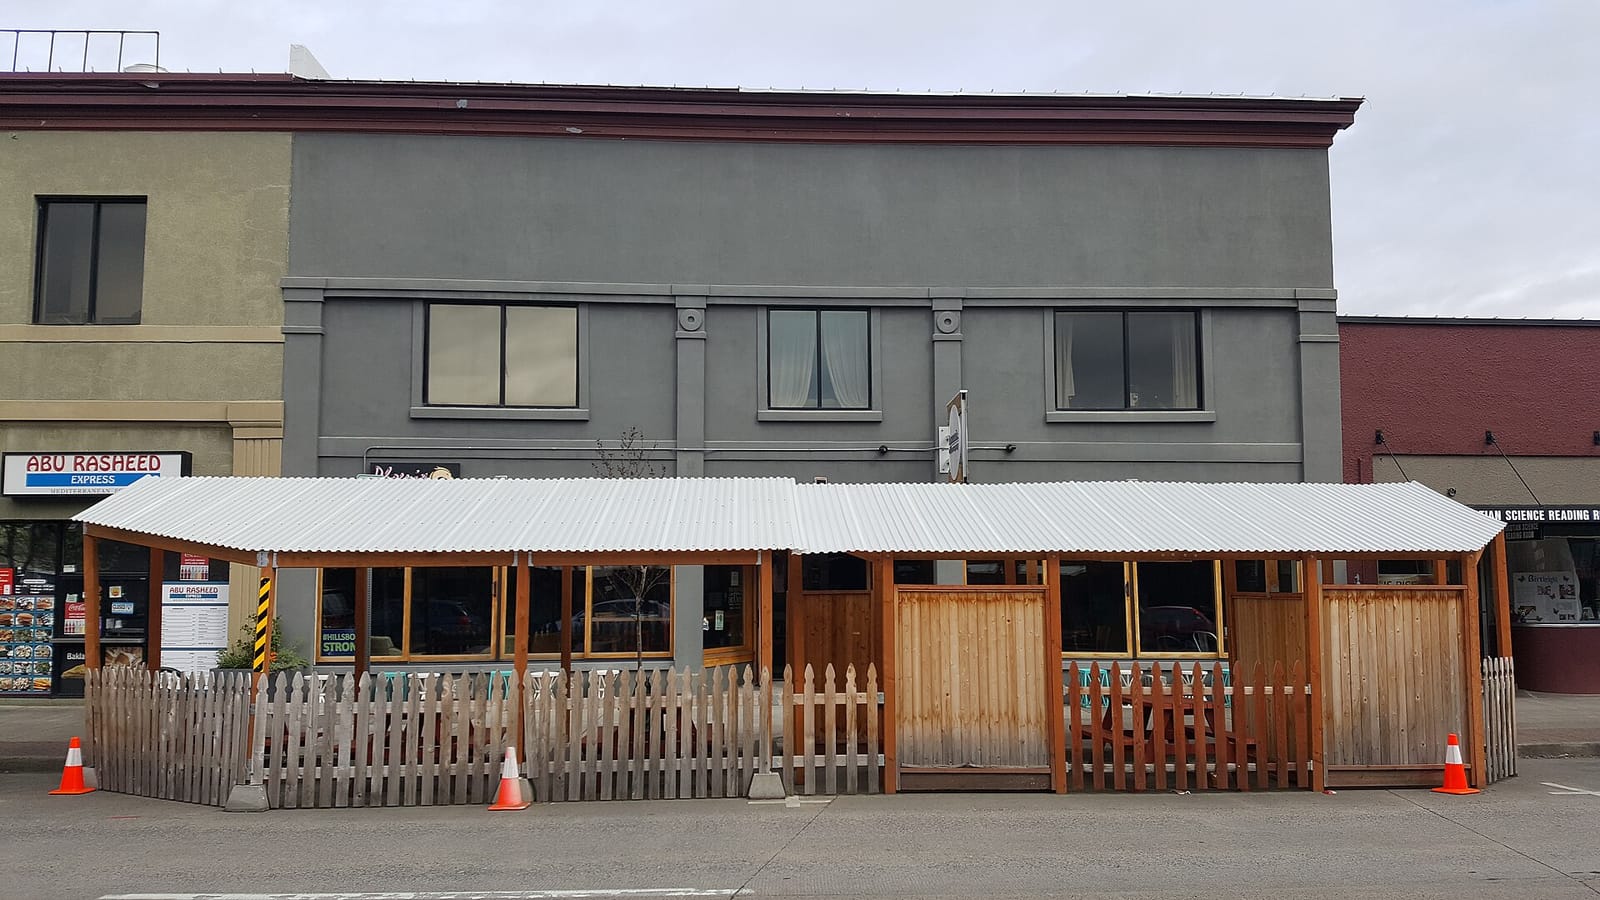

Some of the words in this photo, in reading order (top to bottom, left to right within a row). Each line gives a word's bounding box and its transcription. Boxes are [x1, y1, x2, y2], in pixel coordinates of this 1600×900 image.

[26, 455, 65, 472] ABU
[73, 455, 161, 472] RASHEED
[71, 475, 116, 484] EXPRESS
[1505, 510, 1545, 520] SCIENCE
[1548, 510, 1589, 521] READING
[323, 642, 356, 652] STRON
[67, 652, 86, 660] Bakla
